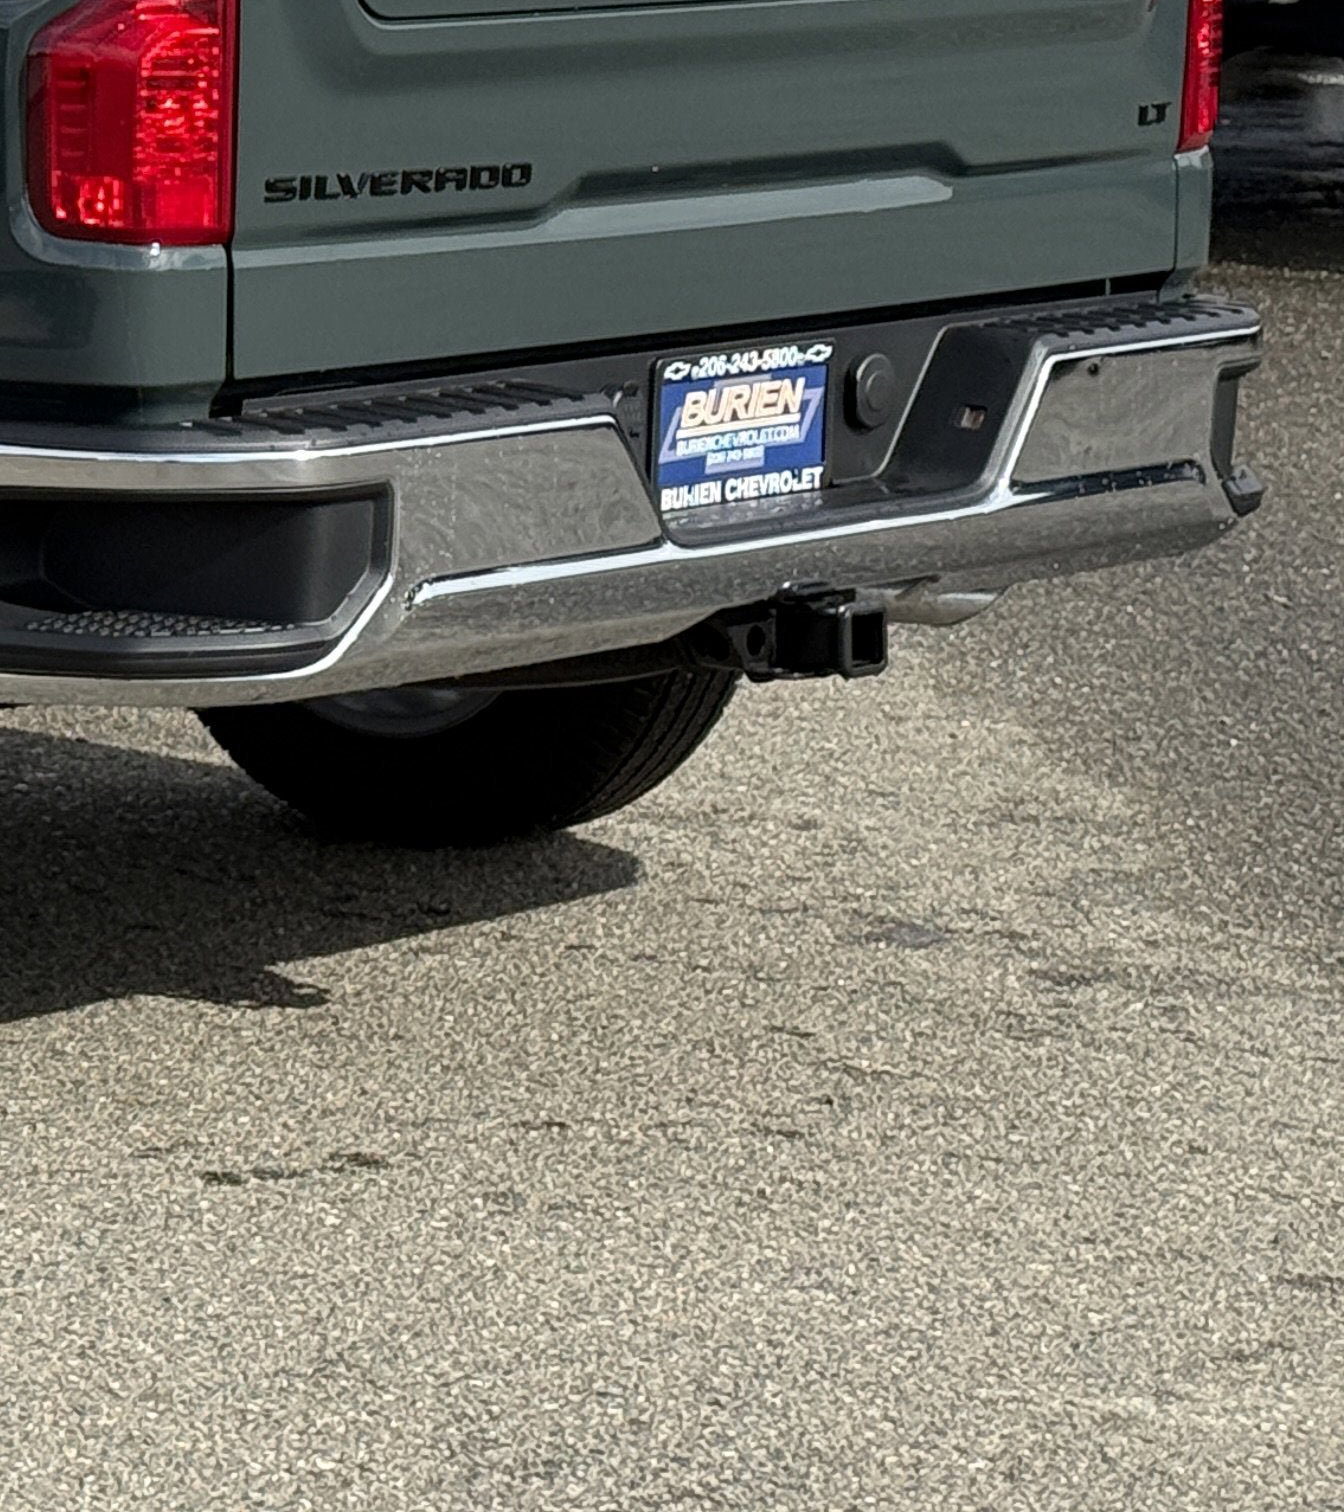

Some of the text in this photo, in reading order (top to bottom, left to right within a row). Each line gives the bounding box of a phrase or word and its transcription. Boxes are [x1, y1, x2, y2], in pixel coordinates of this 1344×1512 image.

[1138, 100, 1172, 126] LT
[263, 161, 533, 204] SILVERADO
[680, 377, 805, 428] BURIEN
[661, 466, 824, 512] BURIEN CHEVROLET
